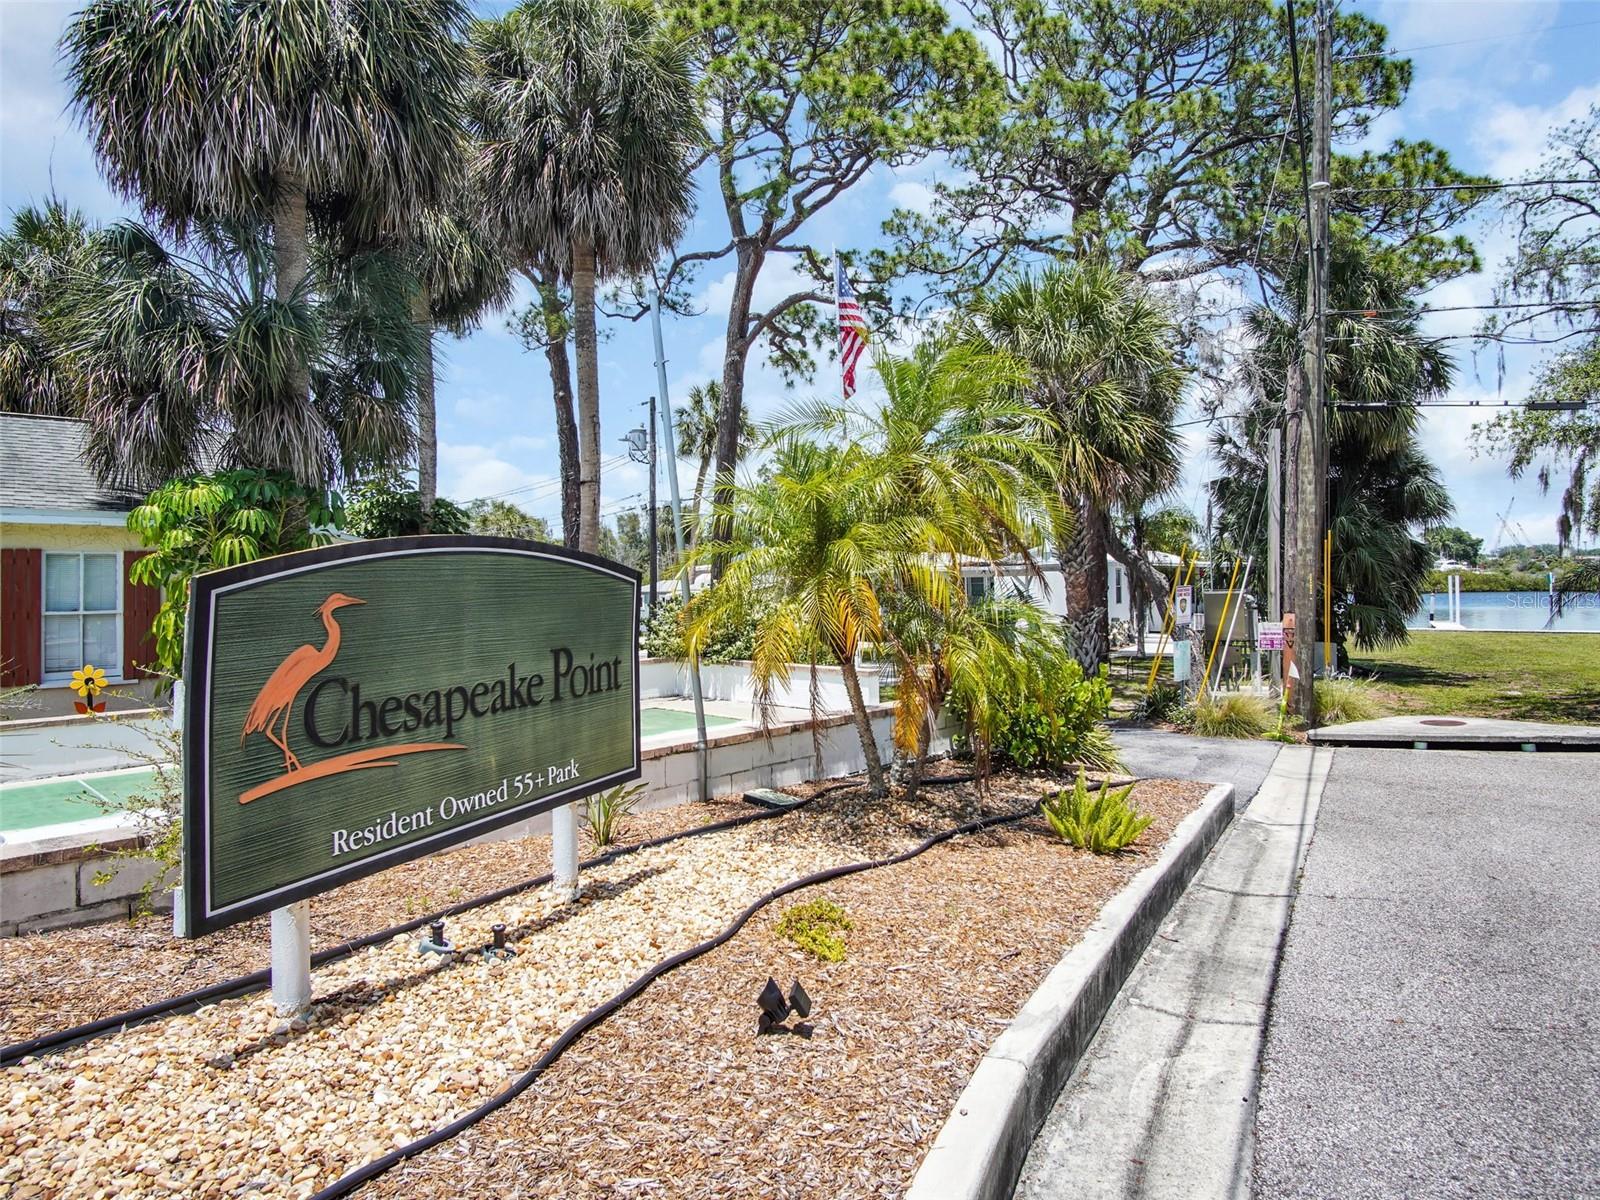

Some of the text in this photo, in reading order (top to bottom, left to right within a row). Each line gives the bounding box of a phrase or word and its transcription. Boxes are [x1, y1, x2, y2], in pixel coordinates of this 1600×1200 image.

[304, 647, 622, 748] Chesapeake Point
[331, 758, 580, 857] Resident Owned 55+ Park
